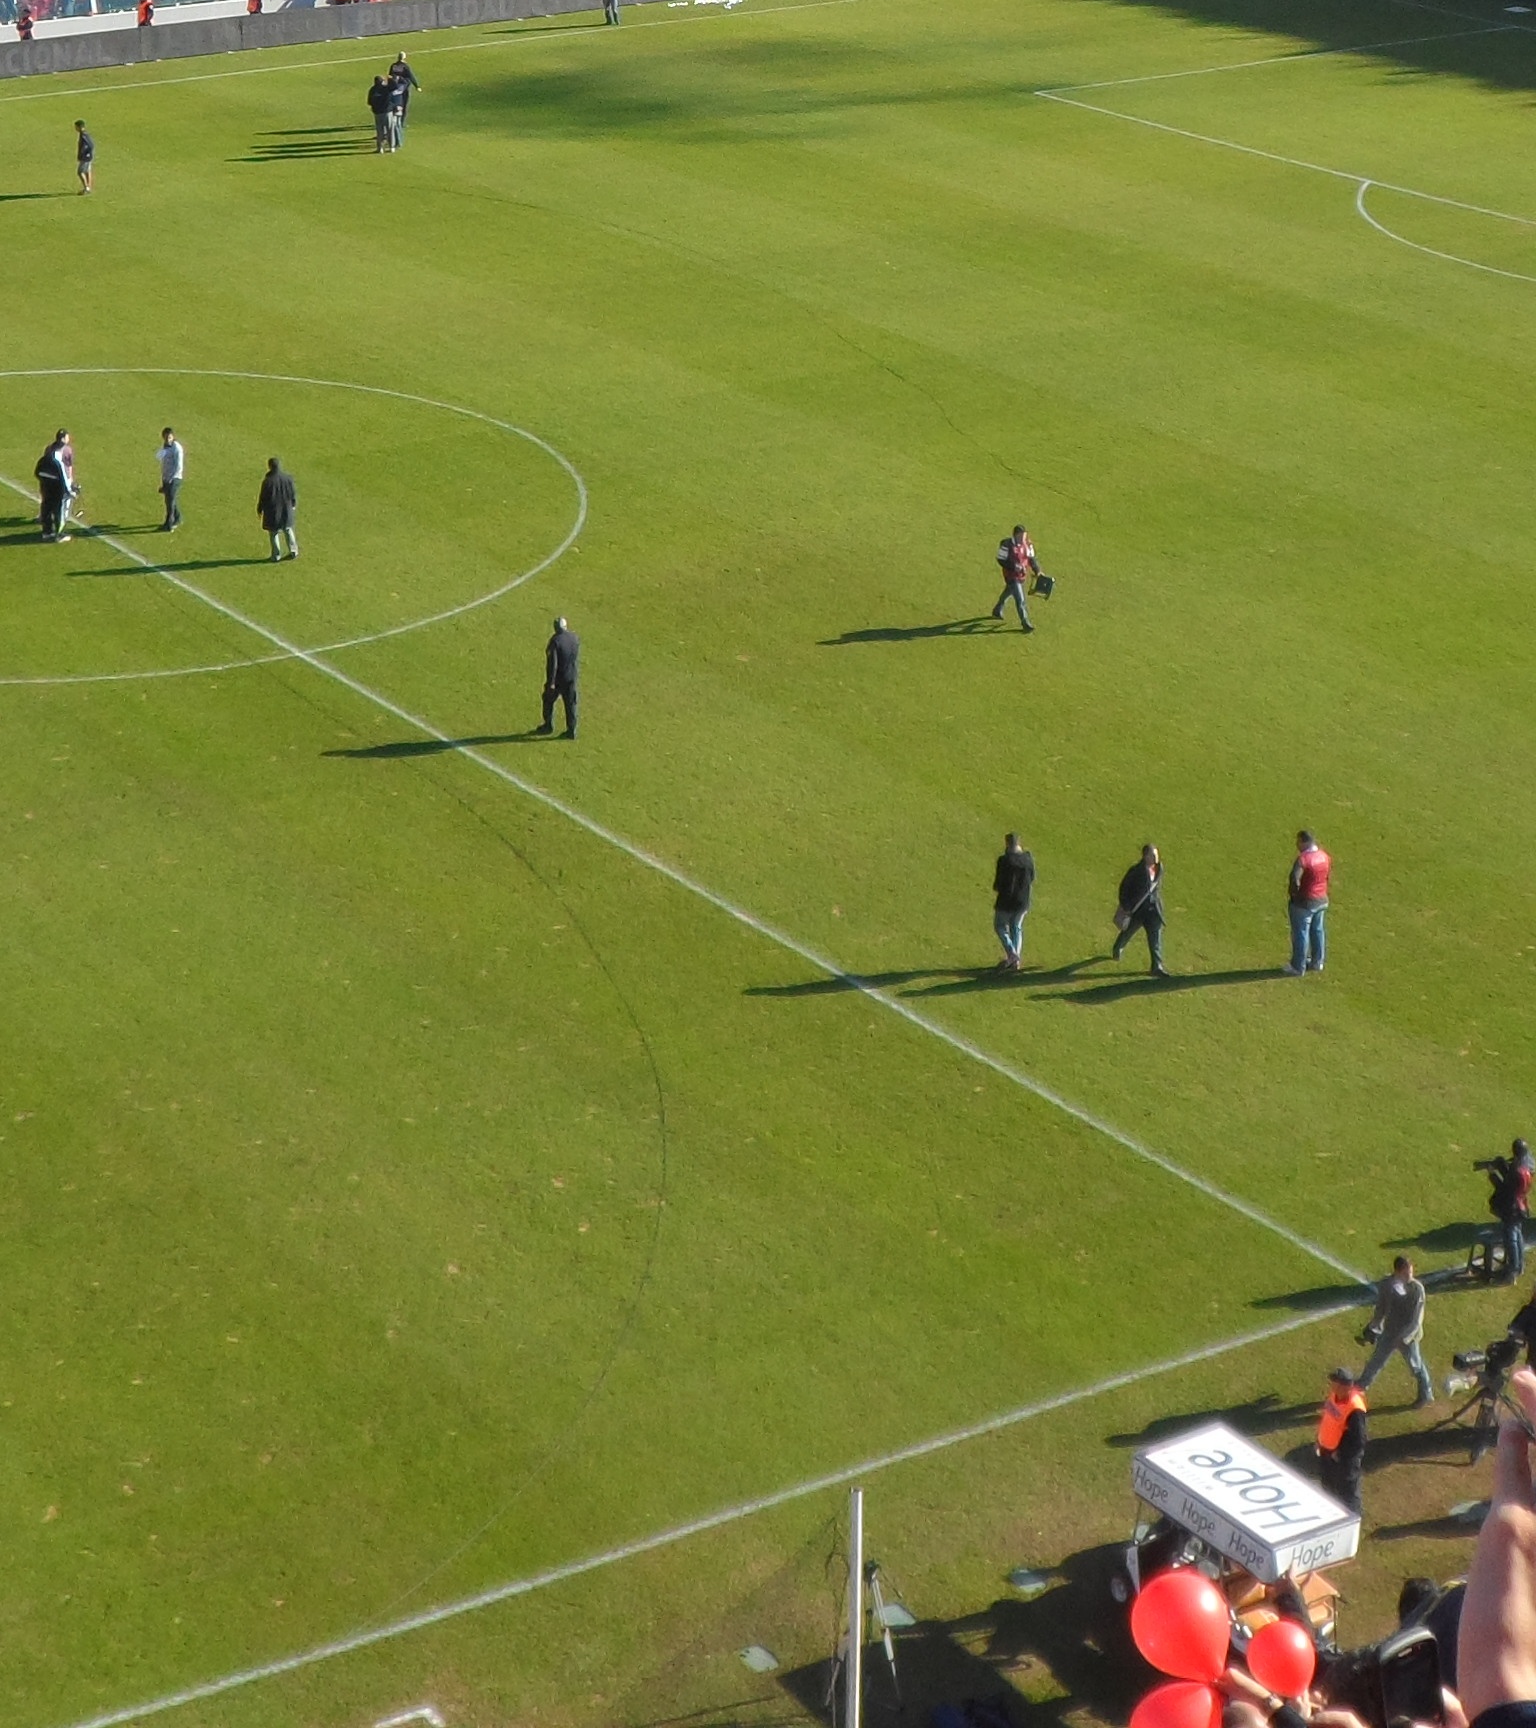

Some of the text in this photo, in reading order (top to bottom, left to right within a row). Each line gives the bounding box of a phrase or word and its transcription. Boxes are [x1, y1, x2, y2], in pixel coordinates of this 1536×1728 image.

[1135, 1465, 1169, 1501] Hope
[1187, 1448, 1322, 1530] Hope
[1182, 1497, 1215, 1535] Hope
[1229, 1530, 1265, 1570] Hope
[1291, 1538, 1335, 1568] Hope
